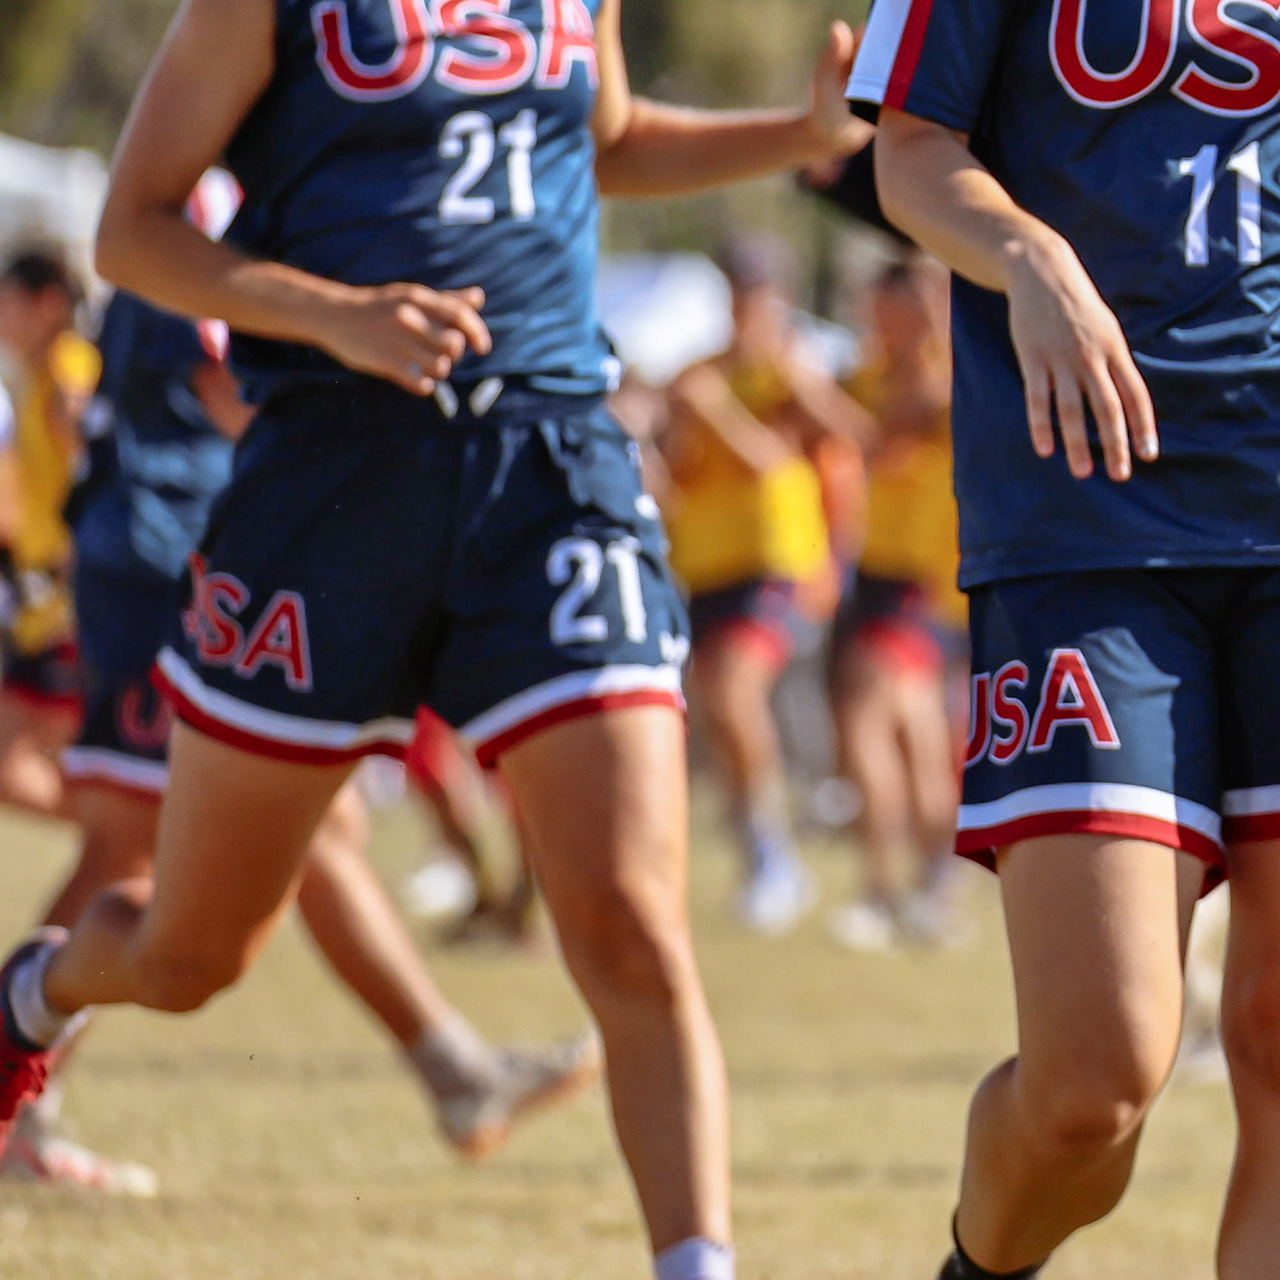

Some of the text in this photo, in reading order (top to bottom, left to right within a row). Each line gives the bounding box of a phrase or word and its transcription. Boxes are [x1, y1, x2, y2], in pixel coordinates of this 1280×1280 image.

[439, 109, 538, 225] 21
[1166, 141, 1261, 266] 11
[547, 535, 646, 645] 21
